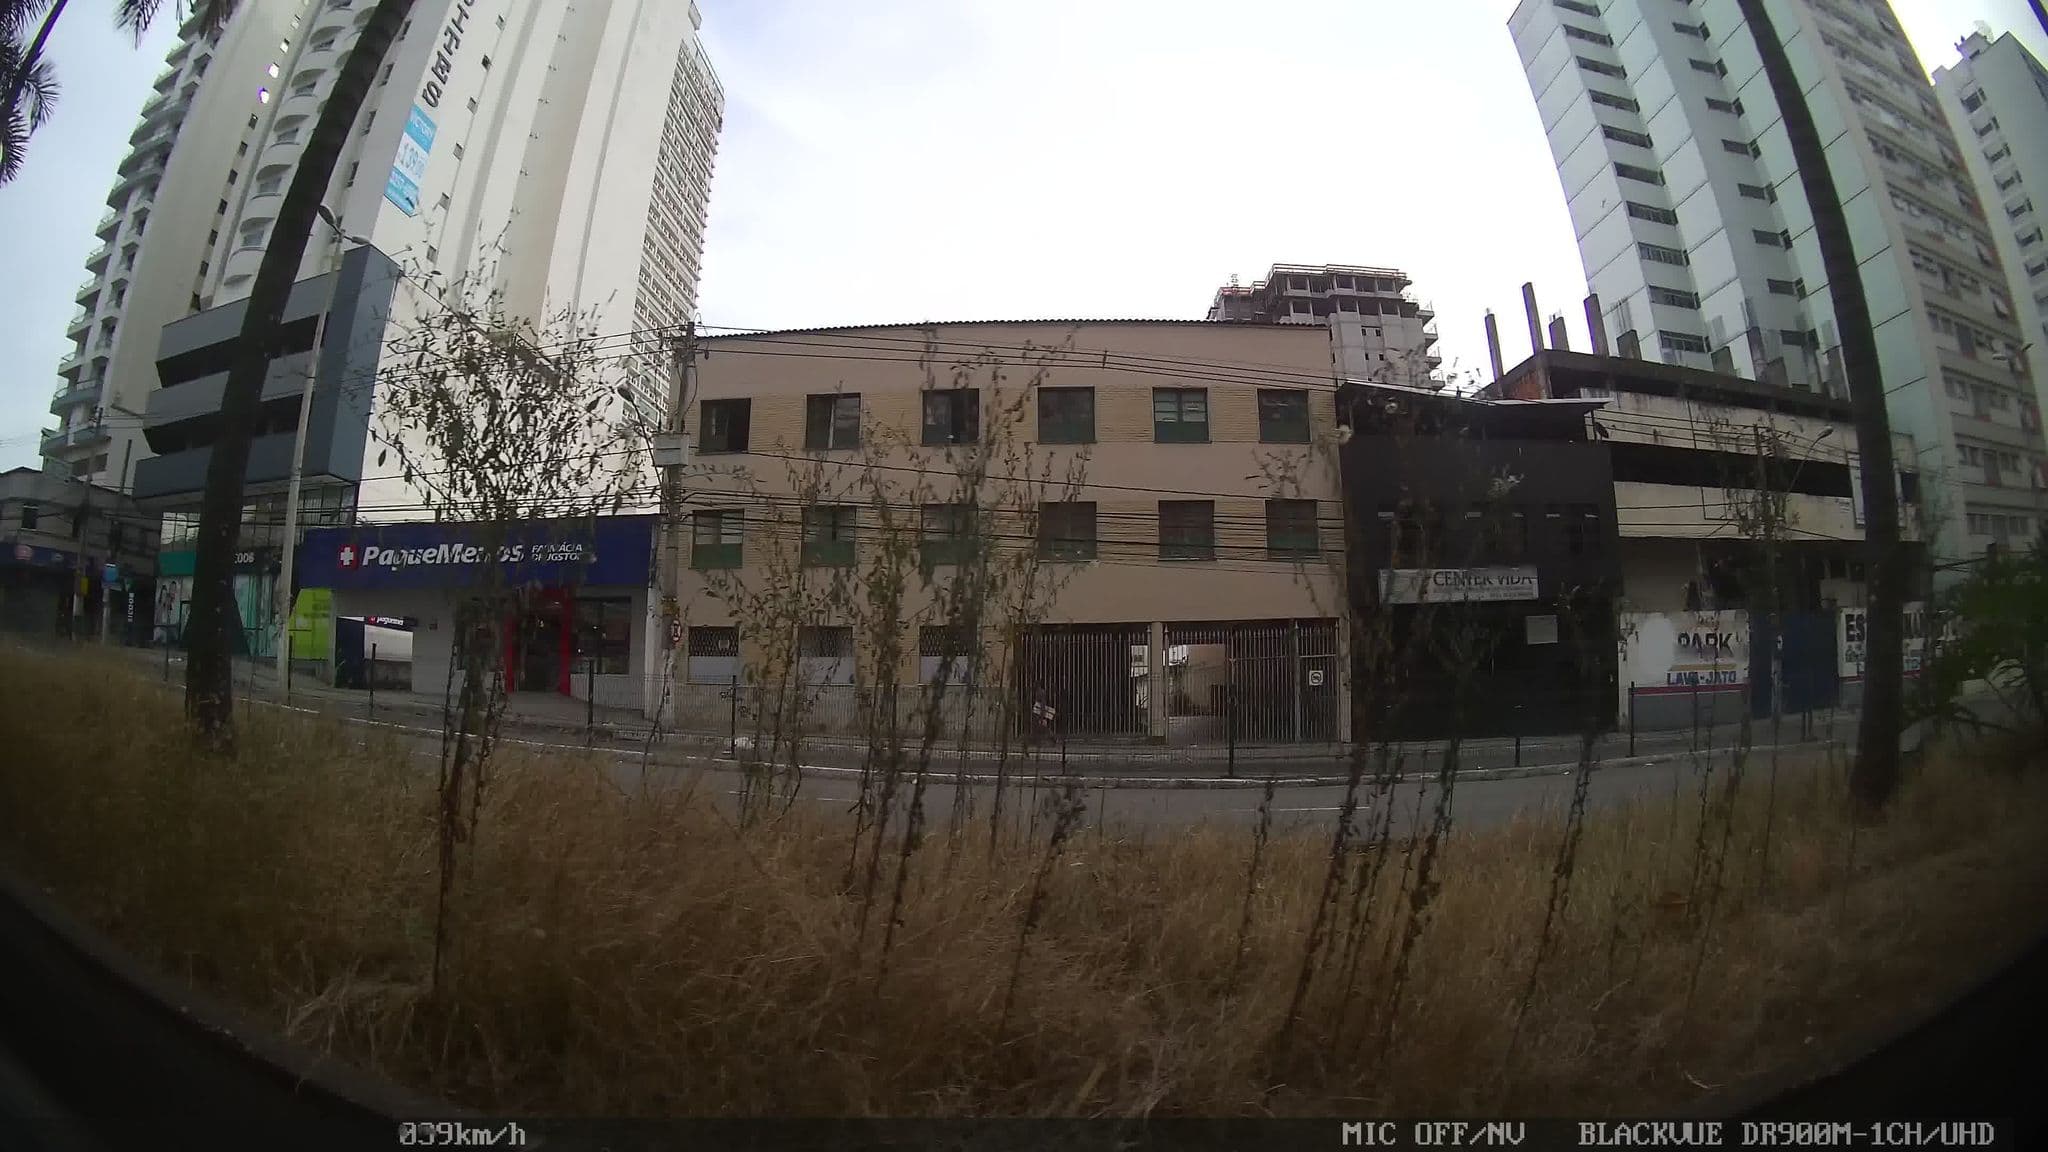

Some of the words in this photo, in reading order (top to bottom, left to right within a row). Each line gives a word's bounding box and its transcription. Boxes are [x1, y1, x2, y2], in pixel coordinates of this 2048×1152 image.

[362, 543, 525, 571] PagueMeos
[1433, 571, 1492, 587] CENTER
[1498, 572, 1533, 586] VIDA
